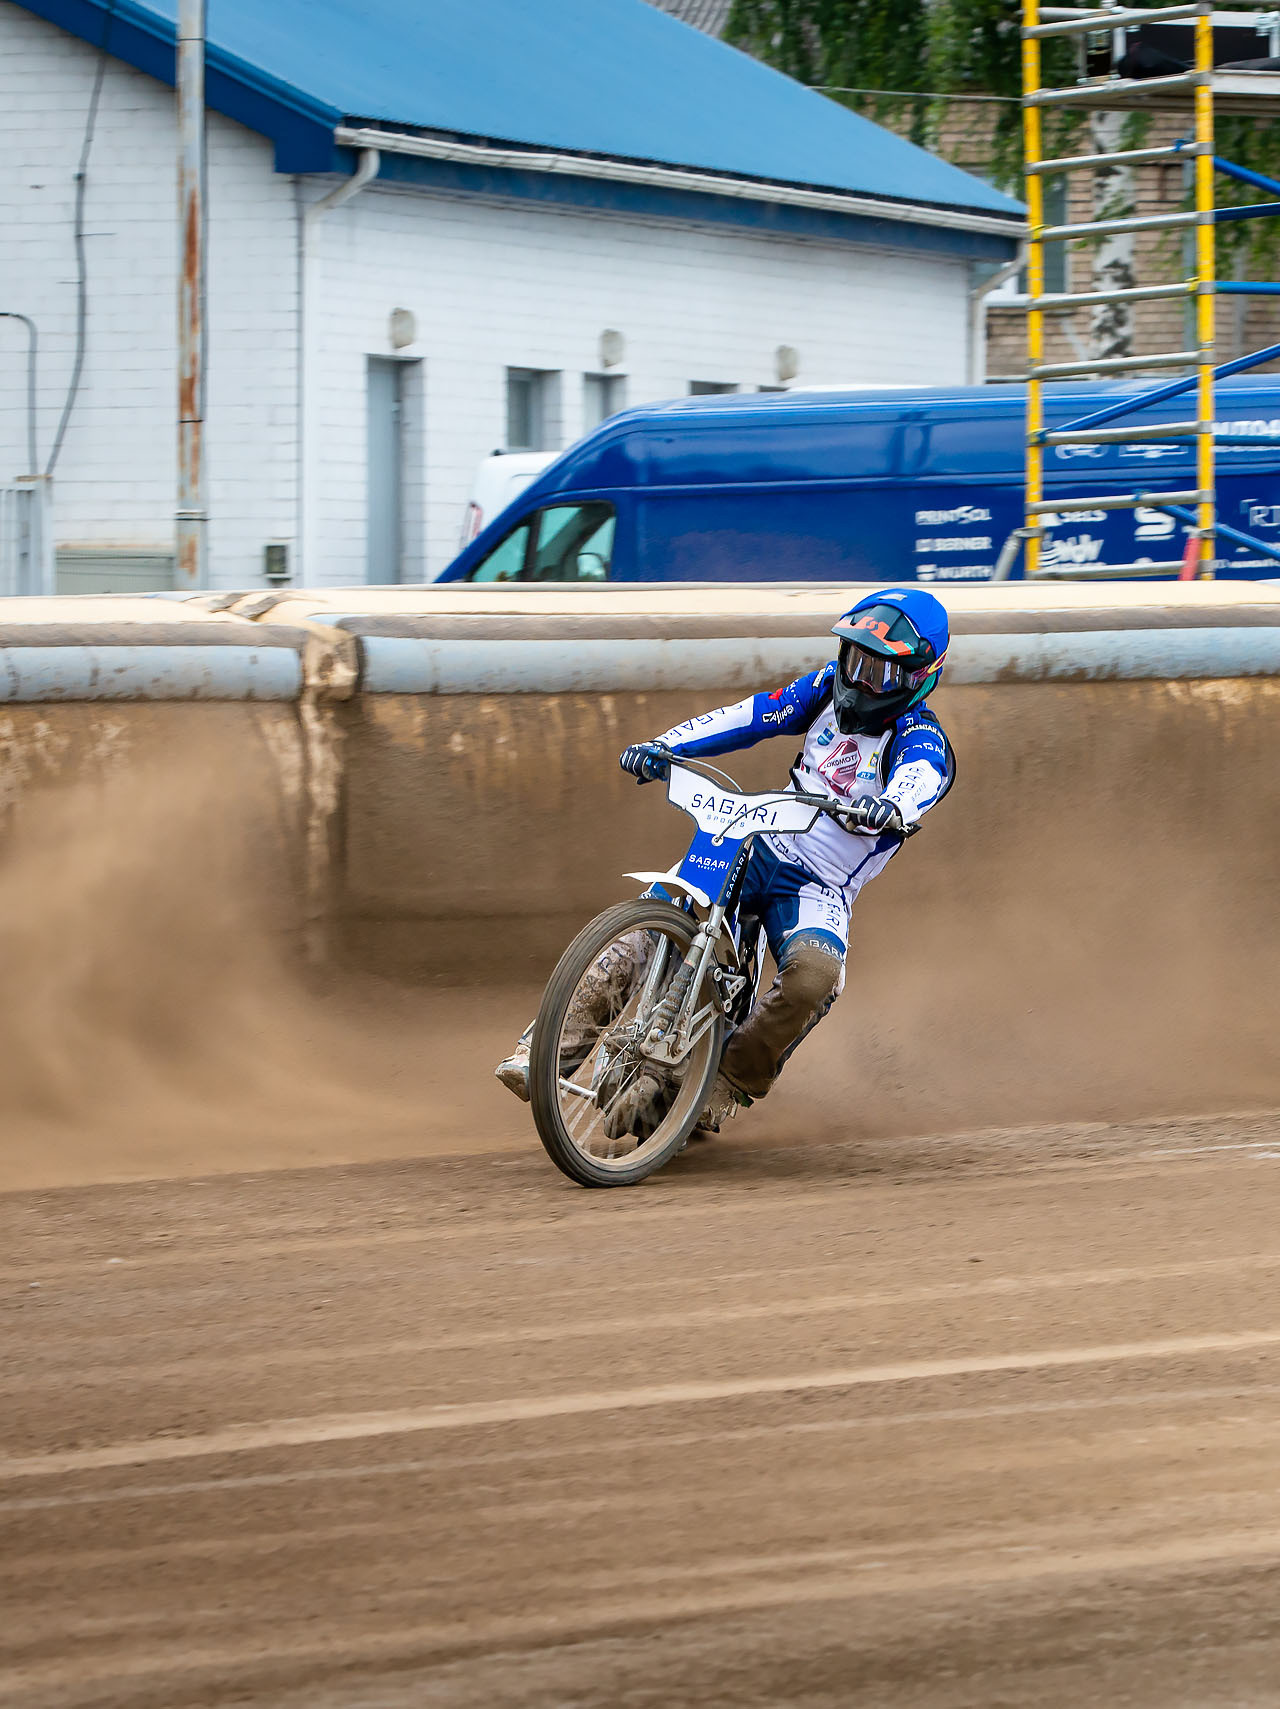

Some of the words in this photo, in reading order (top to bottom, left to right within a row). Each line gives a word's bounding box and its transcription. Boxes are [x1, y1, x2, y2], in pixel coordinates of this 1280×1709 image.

[691, 793, 778, 826] SAGARI
[688, 853, 730, 870] SAGARI
[725, 852, 747, 899] SAGARI
